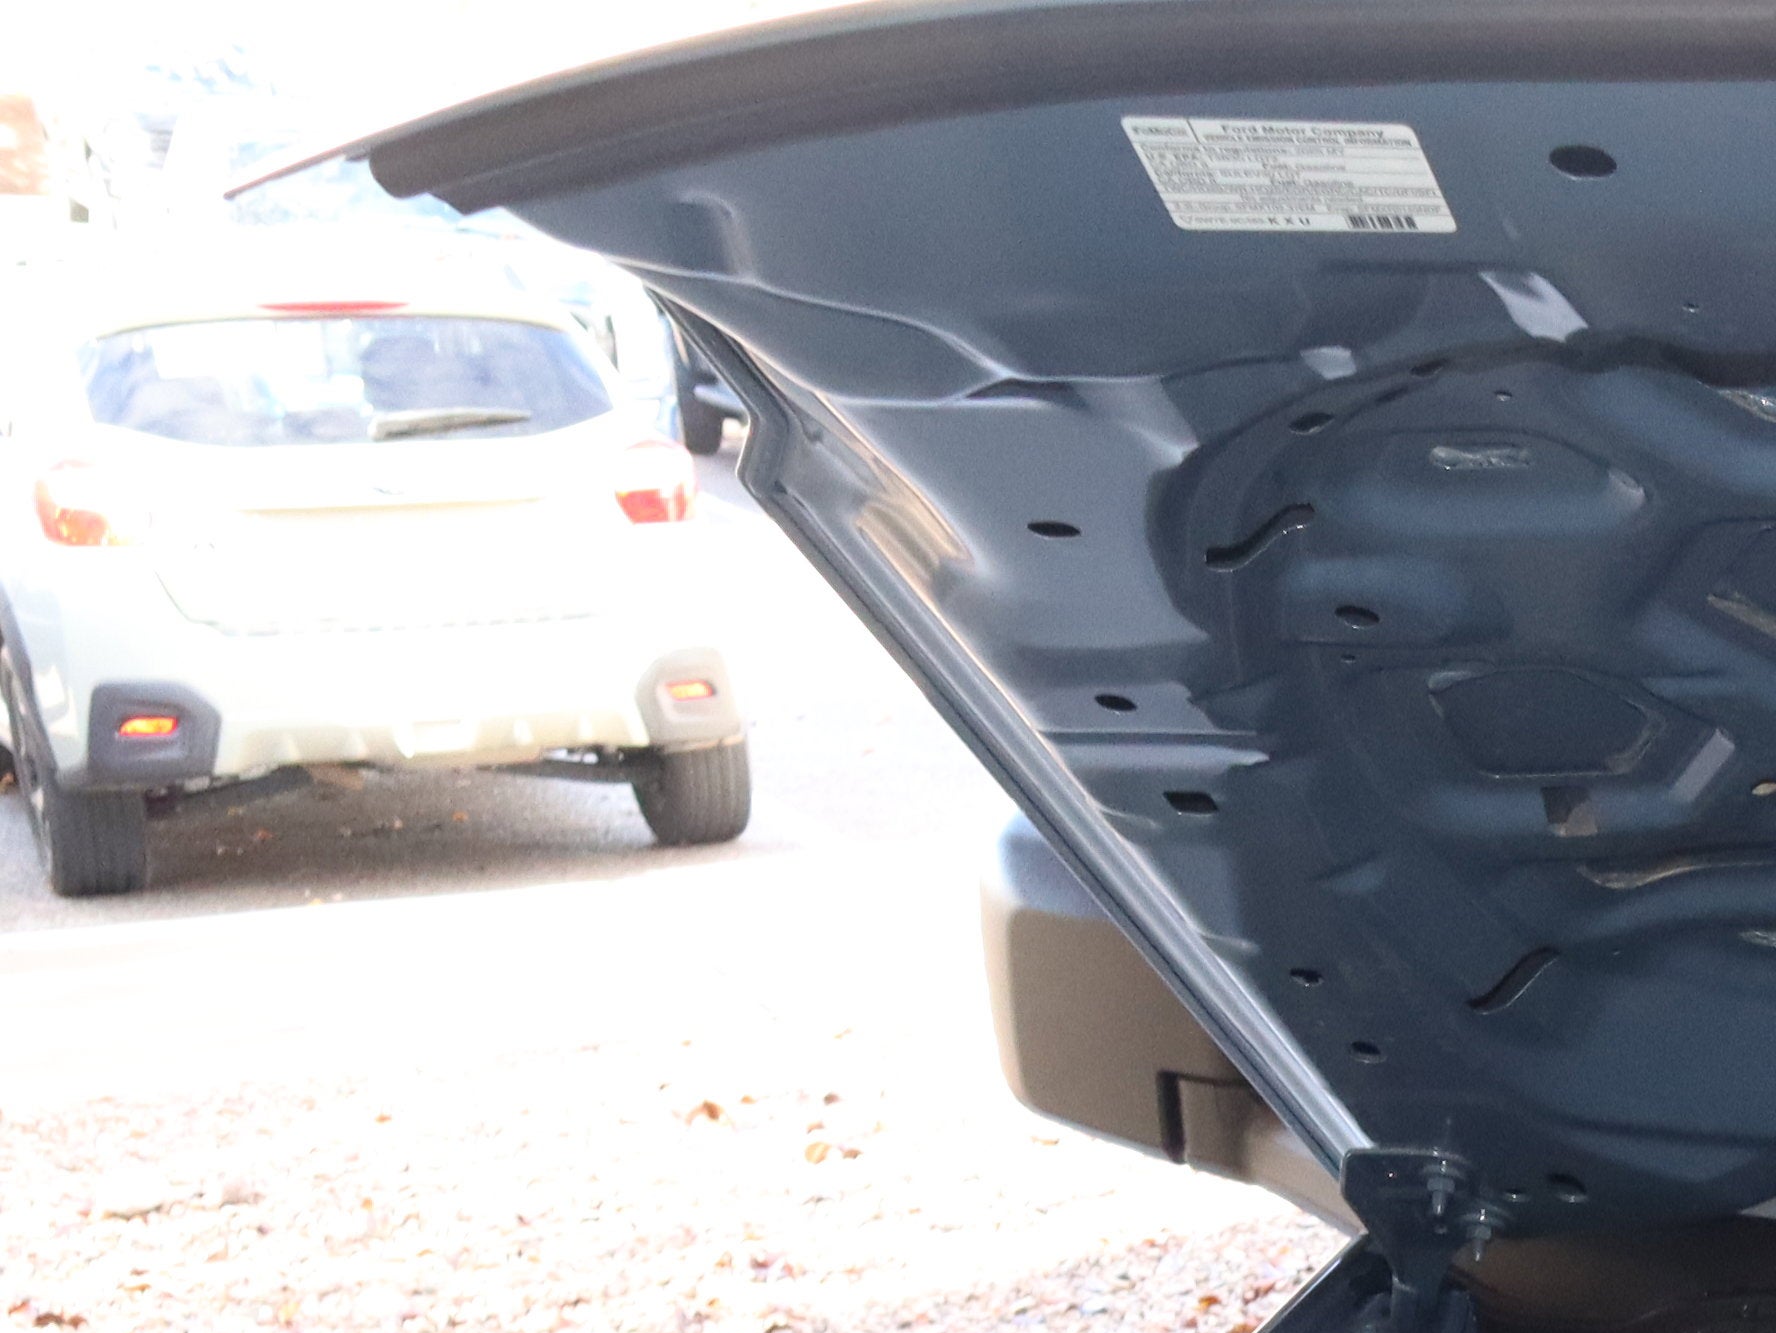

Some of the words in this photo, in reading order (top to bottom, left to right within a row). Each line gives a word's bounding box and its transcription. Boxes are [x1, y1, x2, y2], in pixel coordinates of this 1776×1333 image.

[1219, 125, 1260, 134] Ford
[1260, 126, 1308, 135] Motor
[1309, 127, 1386, 138] Company
